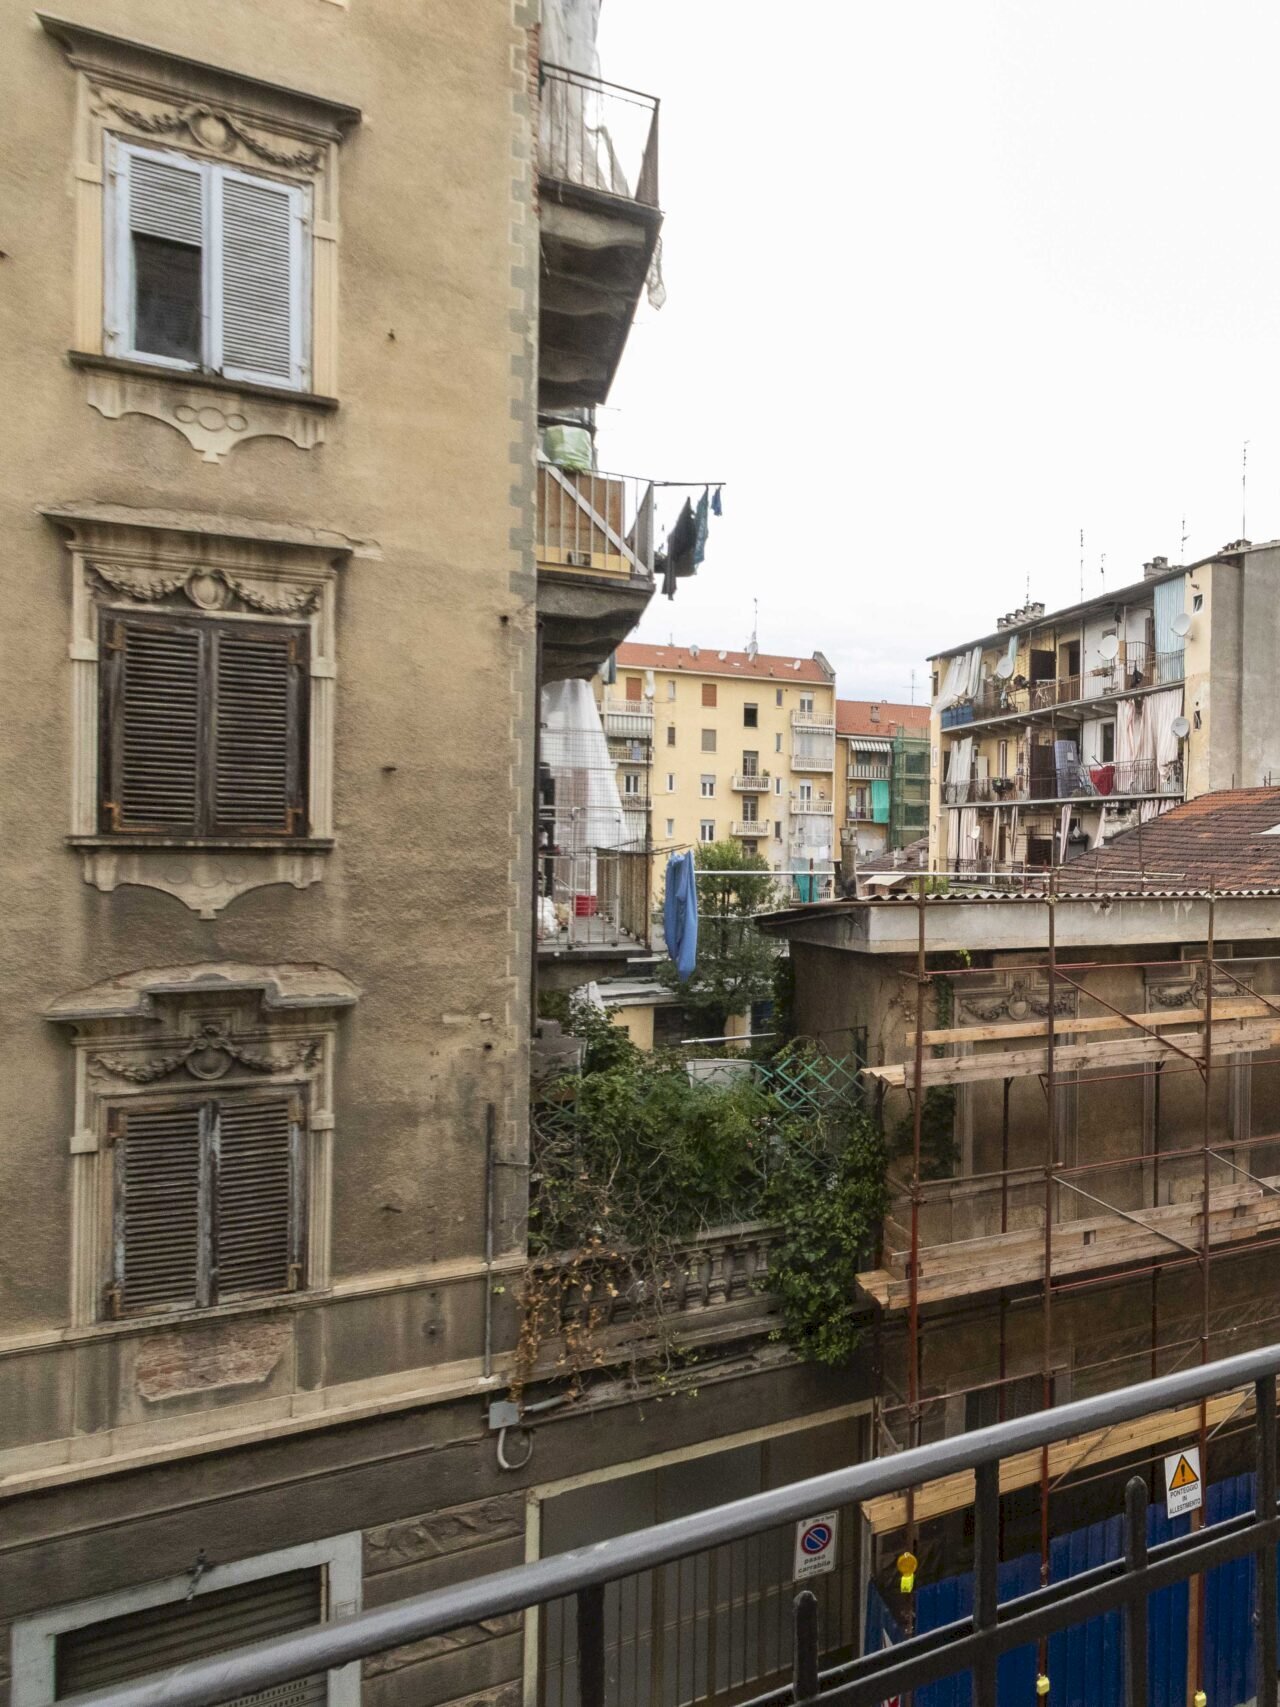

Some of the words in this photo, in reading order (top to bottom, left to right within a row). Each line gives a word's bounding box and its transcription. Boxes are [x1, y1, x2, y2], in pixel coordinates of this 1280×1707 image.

[1170, 1483, 1199, 1498] PONTEGGIO
[1169, 1498, 1201, 1514] ALLESTIMENTO
[798, 1560, 831, 1573] carrabile
[804, 1554, 826, 1565] passo
